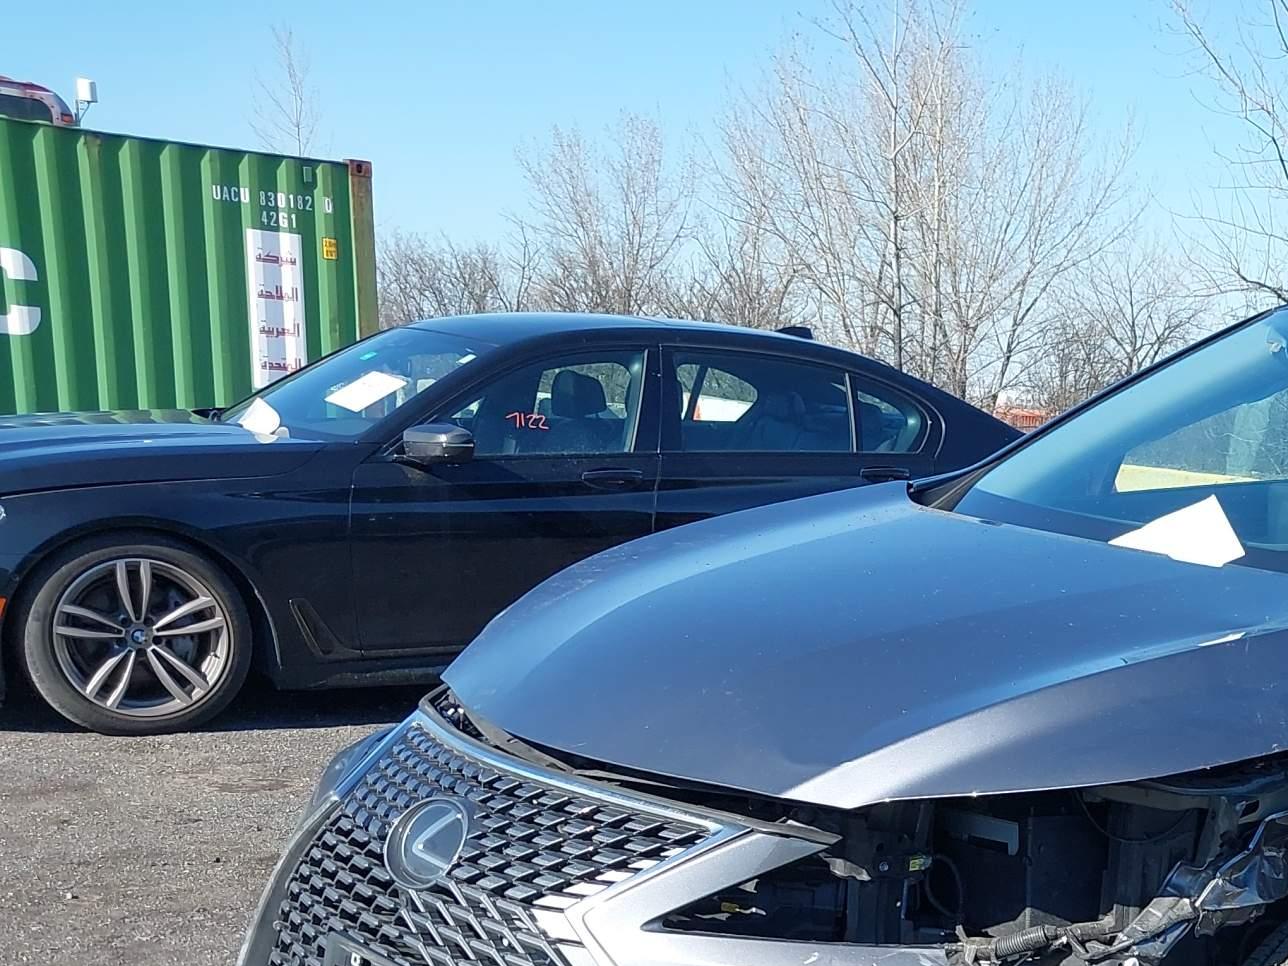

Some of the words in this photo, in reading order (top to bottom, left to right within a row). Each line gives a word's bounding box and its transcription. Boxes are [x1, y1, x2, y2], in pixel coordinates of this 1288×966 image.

[212, 184, 250, 203] UACU
[260, 190, 313, 211] 830182
[261, 210, 297, 229] 42G1
[259, 319, 301, 338] العربية
